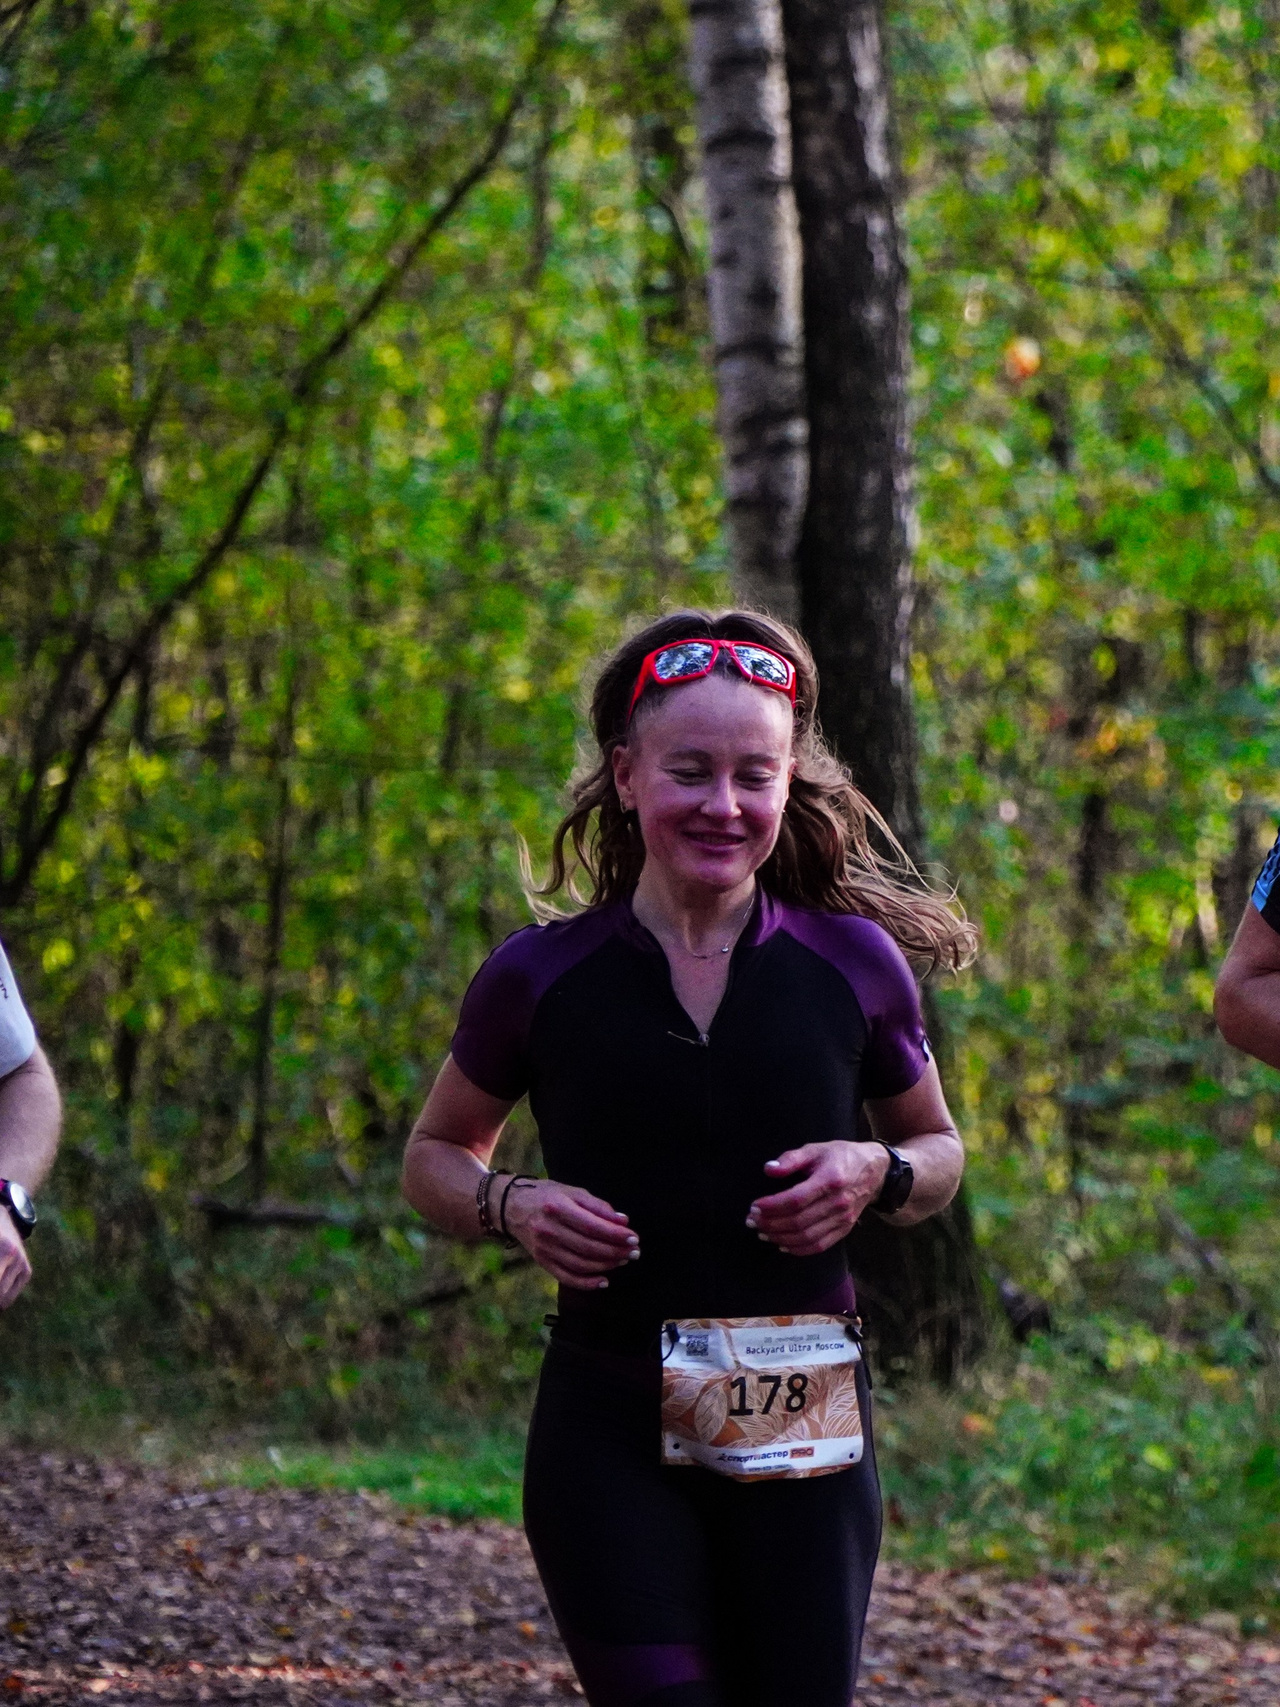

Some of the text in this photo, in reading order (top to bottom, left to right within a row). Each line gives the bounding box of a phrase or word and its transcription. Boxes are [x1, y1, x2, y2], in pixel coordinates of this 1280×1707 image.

[746, 1341, 845, 1355] Backyard Ultra Moscow
[729, 1372, 808, 1416] 178
